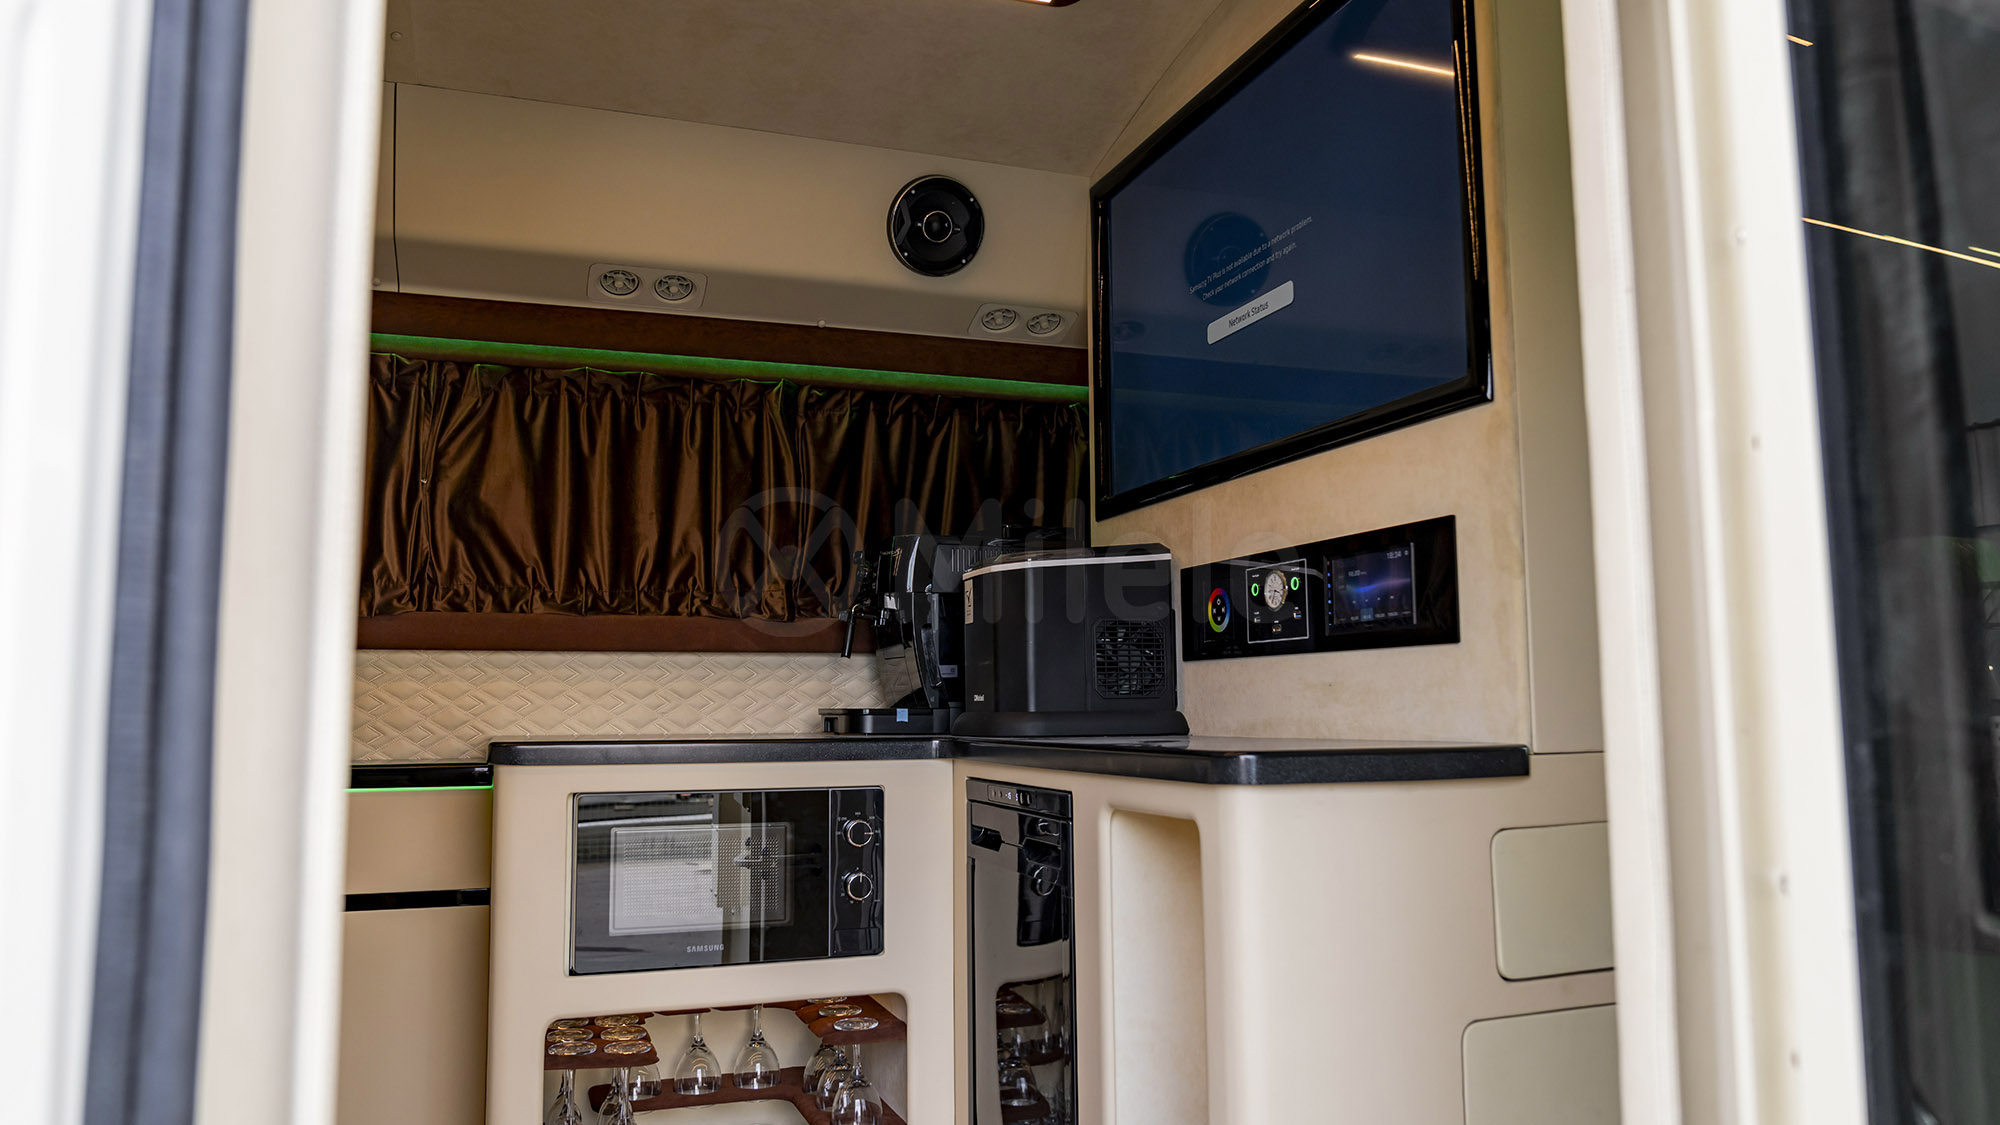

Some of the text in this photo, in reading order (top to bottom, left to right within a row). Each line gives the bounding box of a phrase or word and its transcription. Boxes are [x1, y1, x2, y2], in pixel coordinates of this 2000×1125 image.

[1189, 279, 1207, 294] Samsung
[1207, 275, 1213, 284] TV
[1213, 270, 1222, 280] Plus
[1234, 252, 1252, 268] available
[1253, 246, 1261, 256] due
[1261, 243, 1267, 251] to
[1271, 229, 1290, 245] network
[1202, 289, 1214, 301] Check
[1215, 284, 1224, 295] your
[1224, 273, 1241, 288] network
[1241, 259, 1265, 278] connection
[1266, 253, 1275, 264] and
[1228, 301, 1269, 328] Network Status
[686, 944, 725, 953] SAMSUNG
